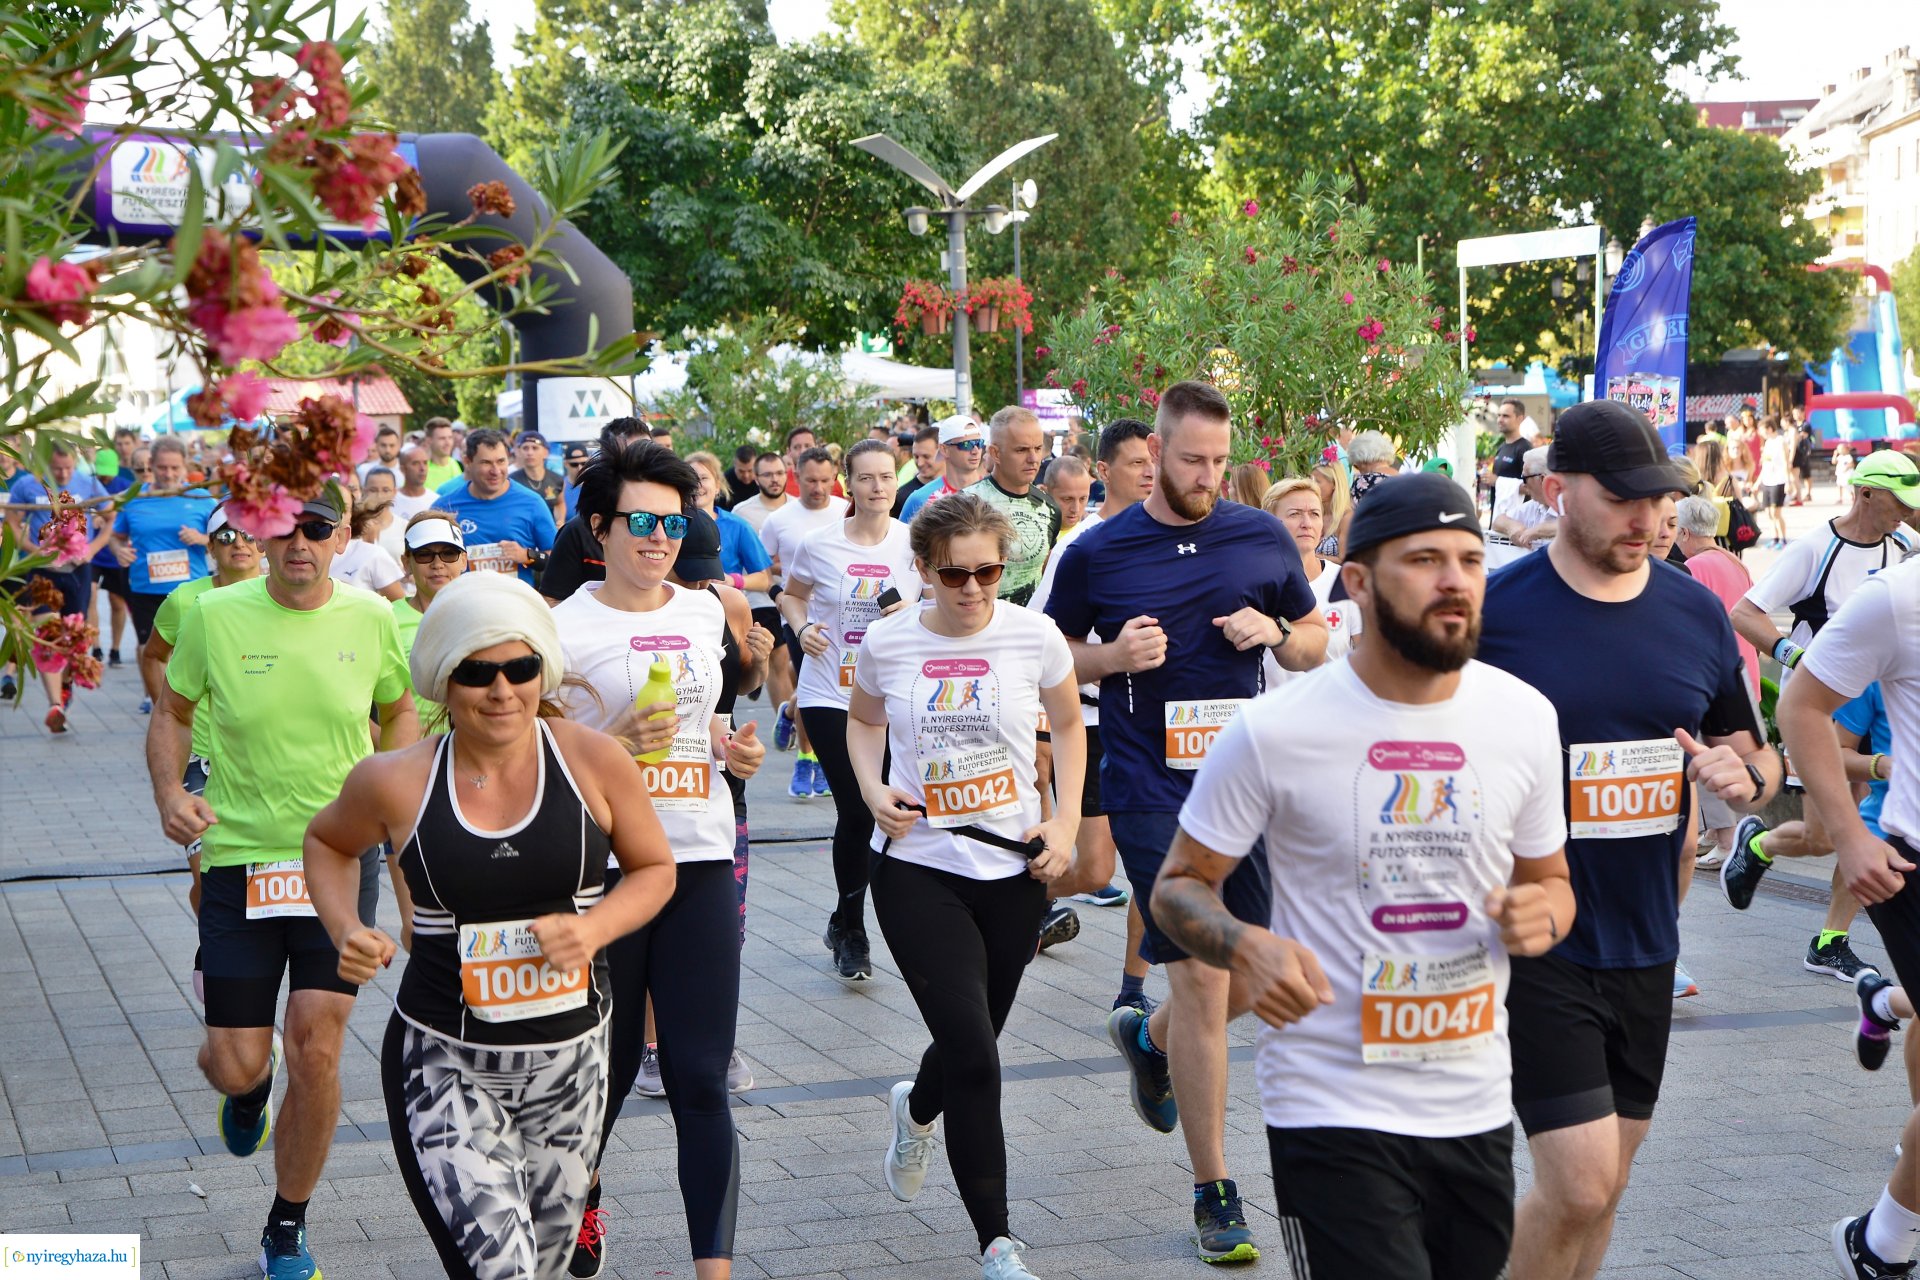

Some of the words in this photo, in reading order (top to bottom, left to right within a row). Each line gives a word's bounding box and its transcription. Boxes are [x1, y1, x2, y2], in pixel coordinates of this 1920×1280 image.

[642, 766, 704, 795] 0041
[931, 775, 1013, 812] 10042
[1582, 779, 1677, 817] 10076
[1374, 991, 1489, 1039] 10047
